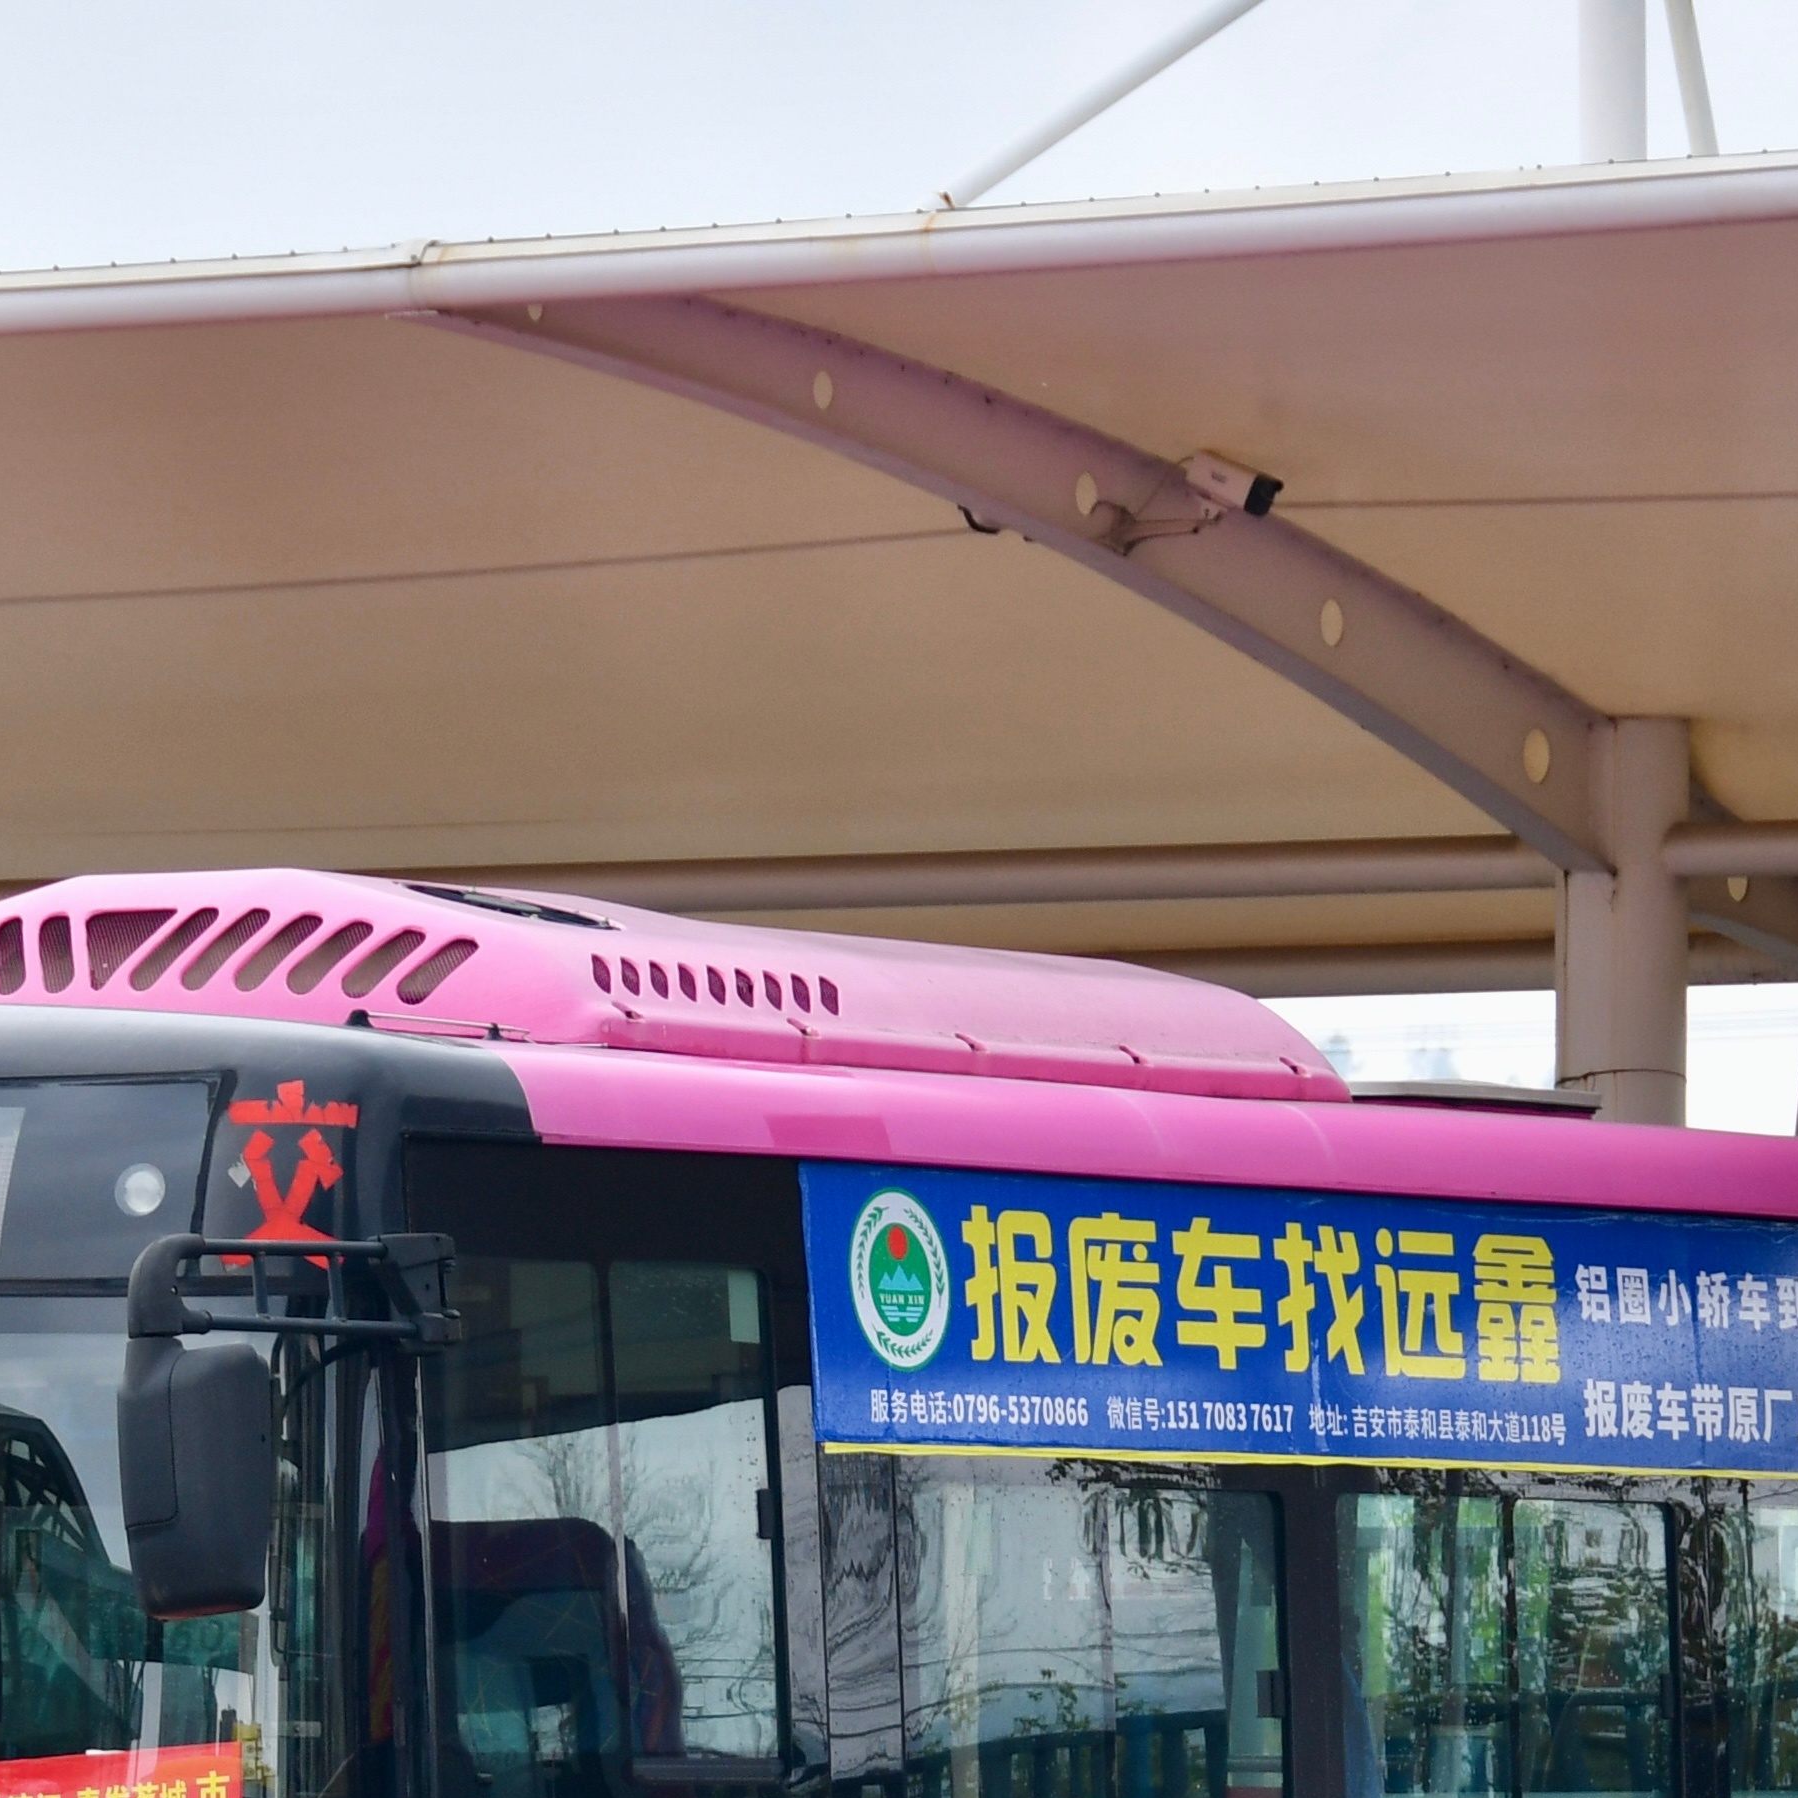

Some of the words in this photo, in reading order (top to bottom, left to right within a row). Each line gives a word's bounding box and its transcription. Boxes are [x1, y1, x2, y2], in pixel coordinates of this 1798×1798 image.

[962, 1204, 1563, 1384] 报废车找远鑫
[870, 1388, 1089, 1426] 服务电话:0796-5370866
